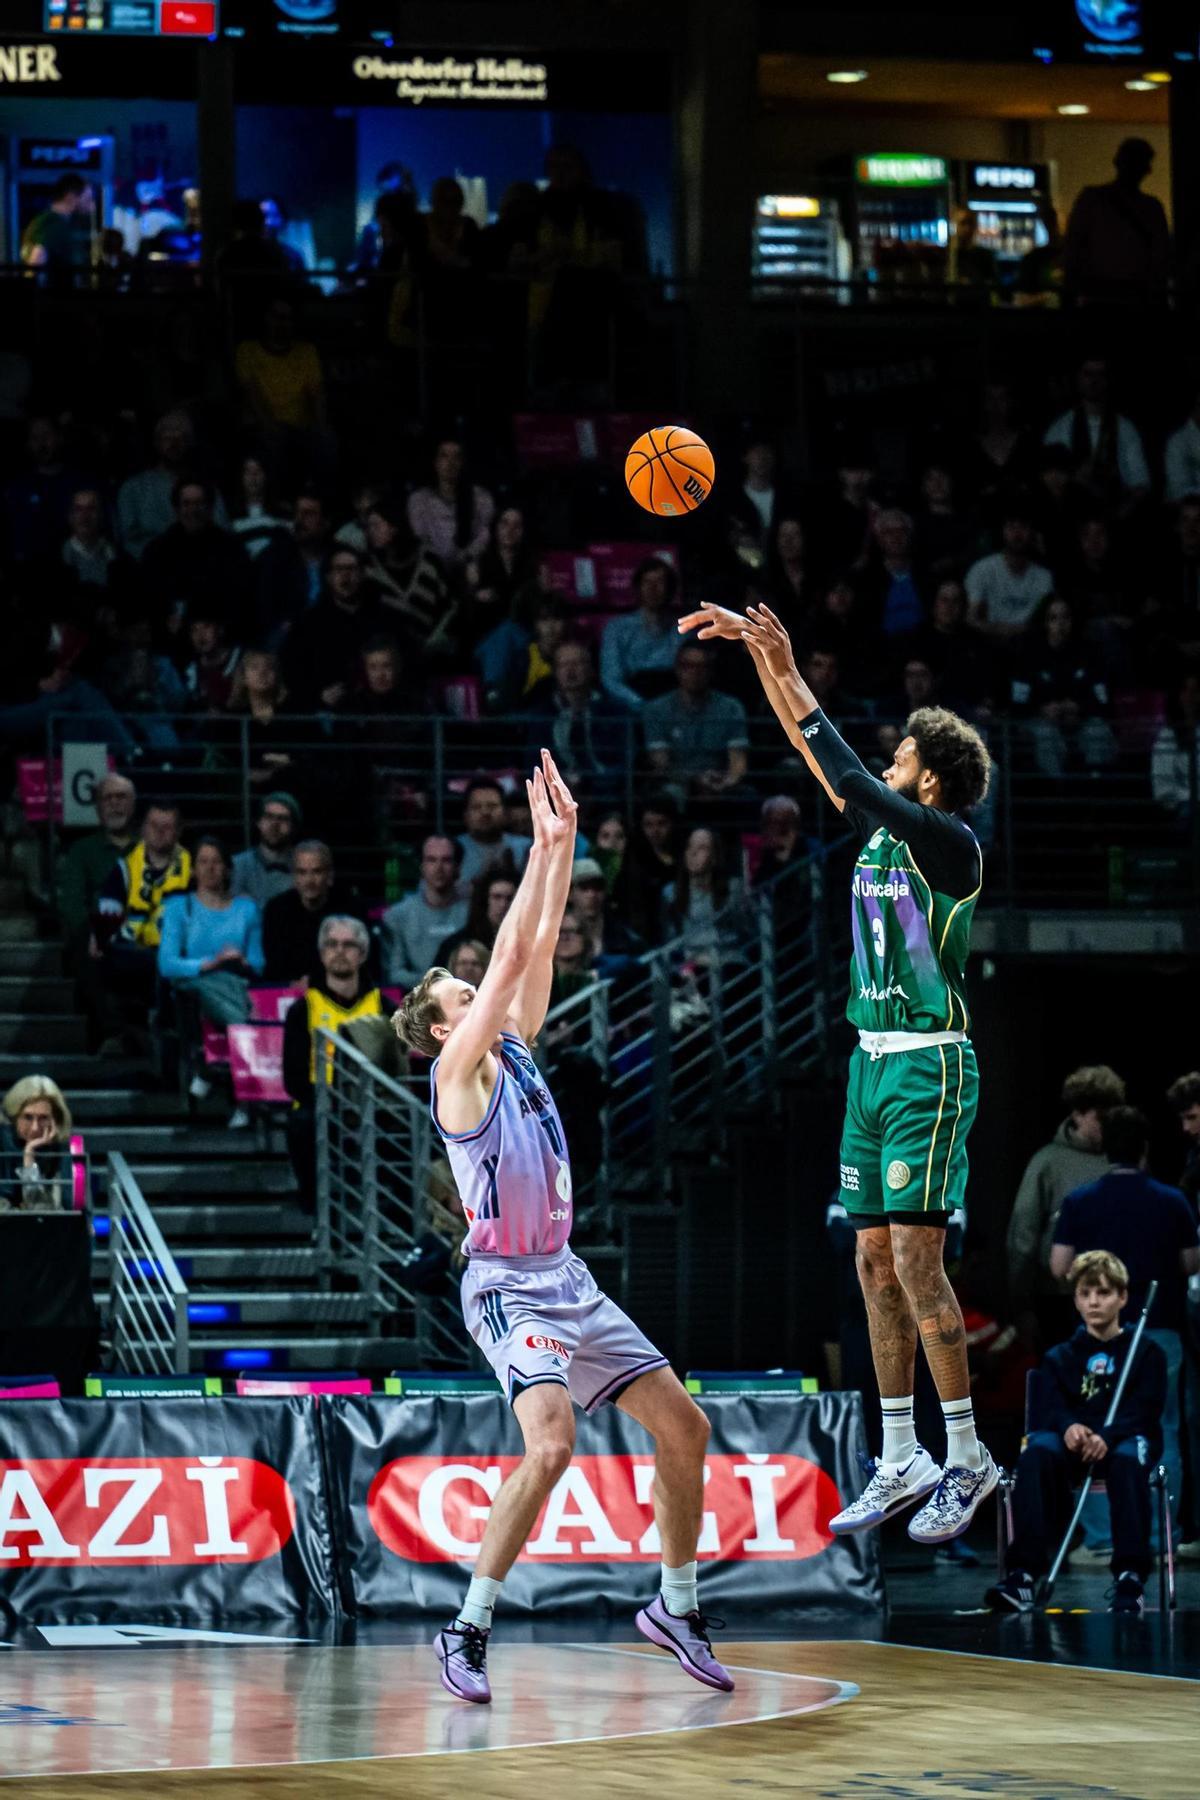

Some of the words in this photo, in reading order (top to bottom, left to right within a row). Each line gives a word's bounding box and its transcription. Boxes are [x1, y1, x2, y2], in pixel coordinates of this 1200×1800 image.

[0, 45, 61, 82] NER
[975, 166, 1036, 188] PEPSI
[861, 880, 909, 900] Unicaja
[872, 918, 885, 957] 3
